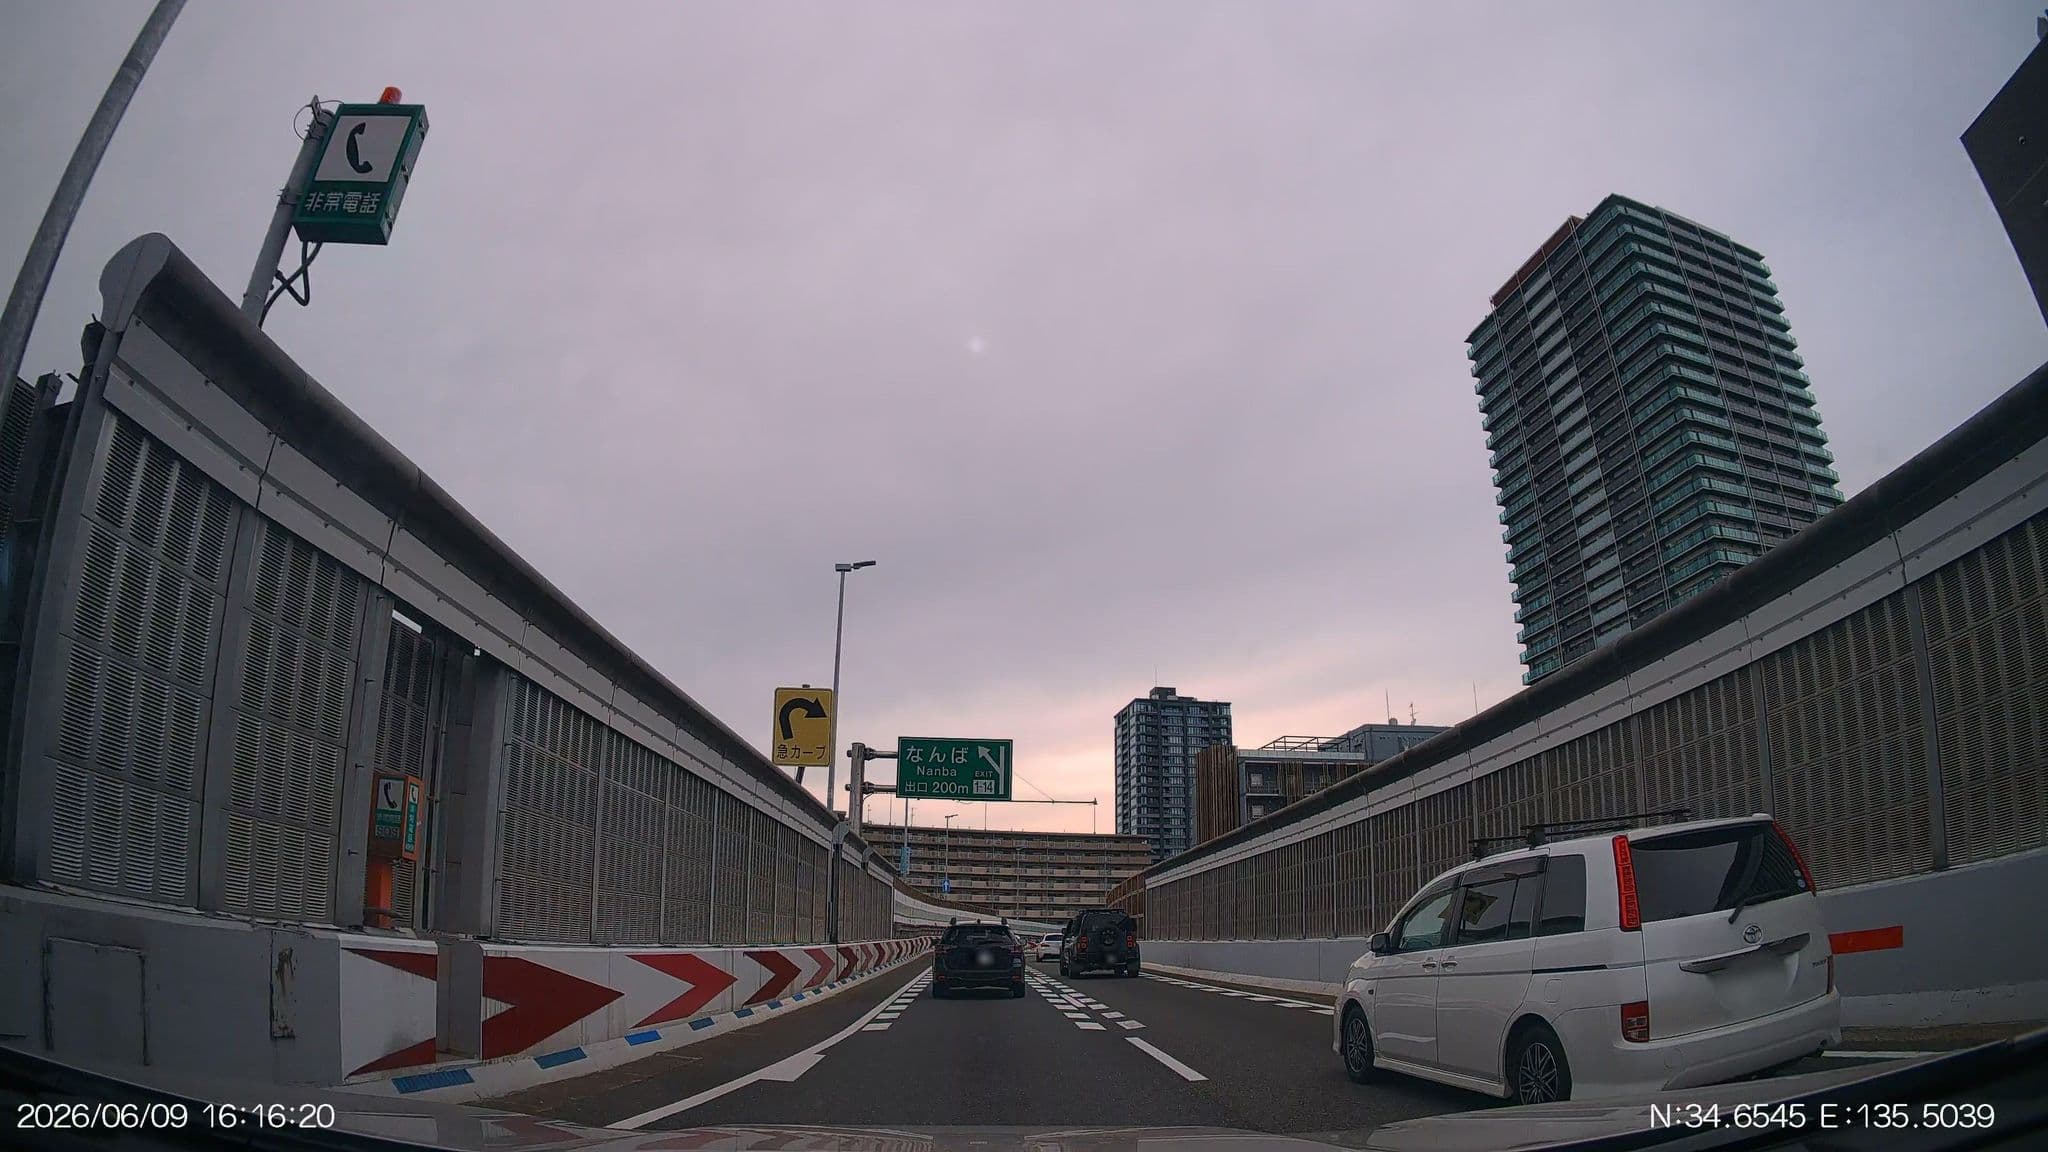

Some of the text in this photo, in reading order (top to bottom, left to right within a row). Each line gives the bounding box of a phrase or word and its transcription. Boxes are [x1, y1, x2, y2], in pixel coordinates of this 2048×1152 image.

[305, 191, 380, 213] 非常電話
[906, 745, 969, 764] なんば
[917, 765, 957, 777] Nanba
[975, 770, 993, 778] EXIT
[904, 780, 969, 794] 出口 200m
[974, 780, 993, 793] 1-14
